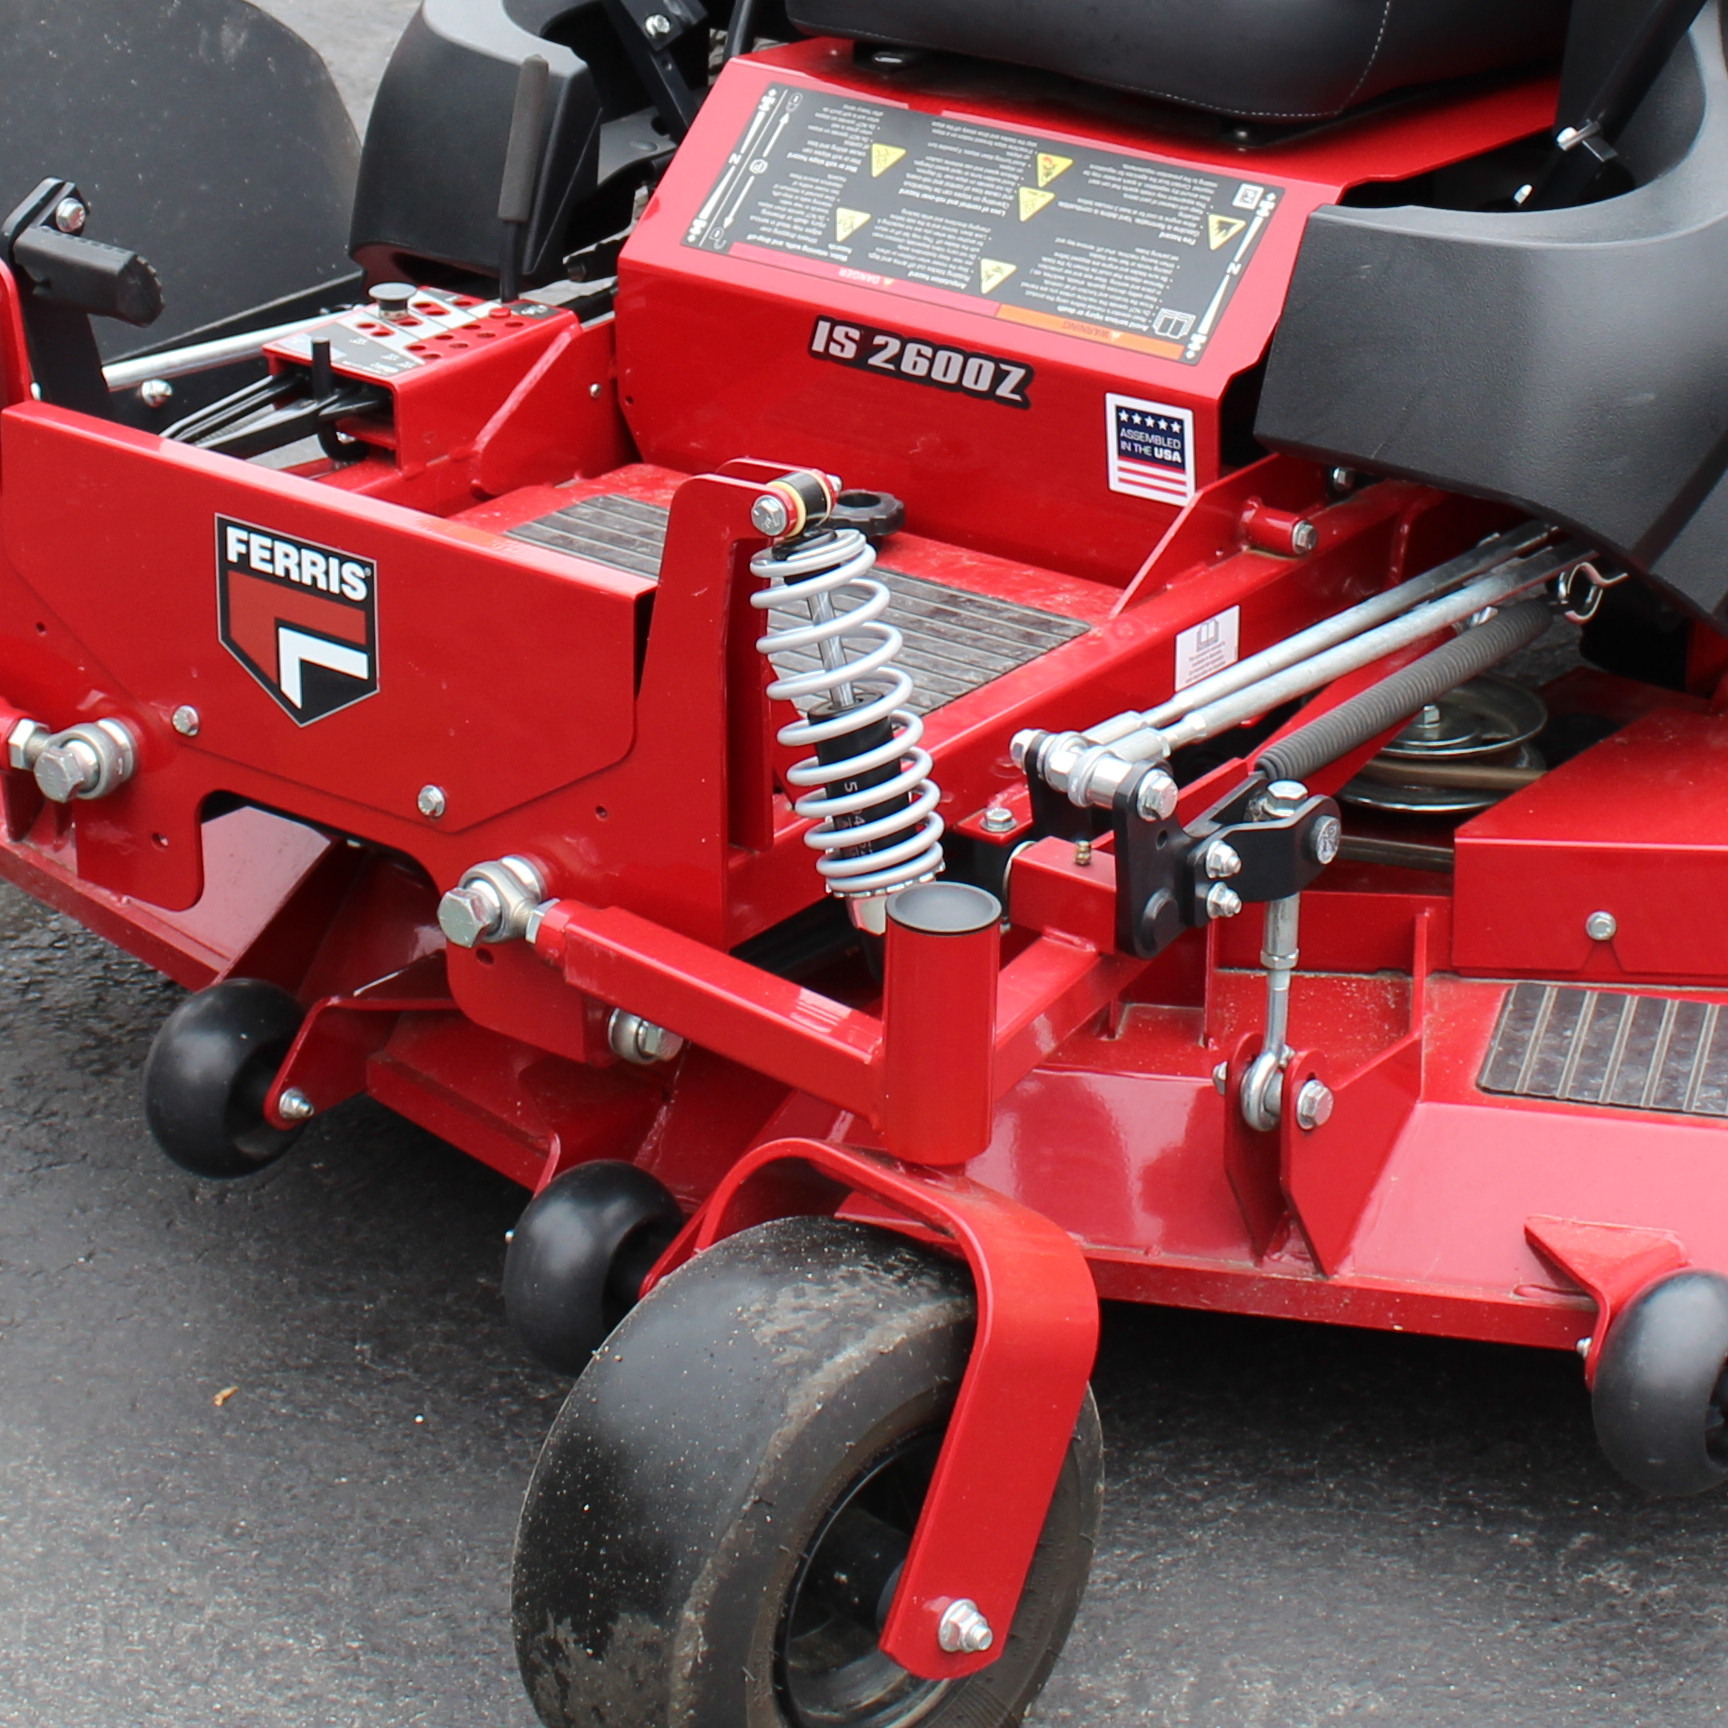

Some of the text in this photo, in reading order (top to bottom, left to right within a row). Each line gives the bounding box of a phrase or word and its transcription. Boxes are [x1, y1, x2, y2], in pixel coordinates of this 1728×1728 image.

[728, 154, 741, 164] N
[837, 266, 881, 284] DANGER
[1226, 262, 1242, 274] N
[1061, 320, 1110, 338] WARNING
[811, 320, 1027, 402] IS 2600Z
[1120, 428, 1182, 450] ASSEMBLED
[1120, 440, 1182, 463] IN THE USA
[227, 526, 367, 601] FERRIS
